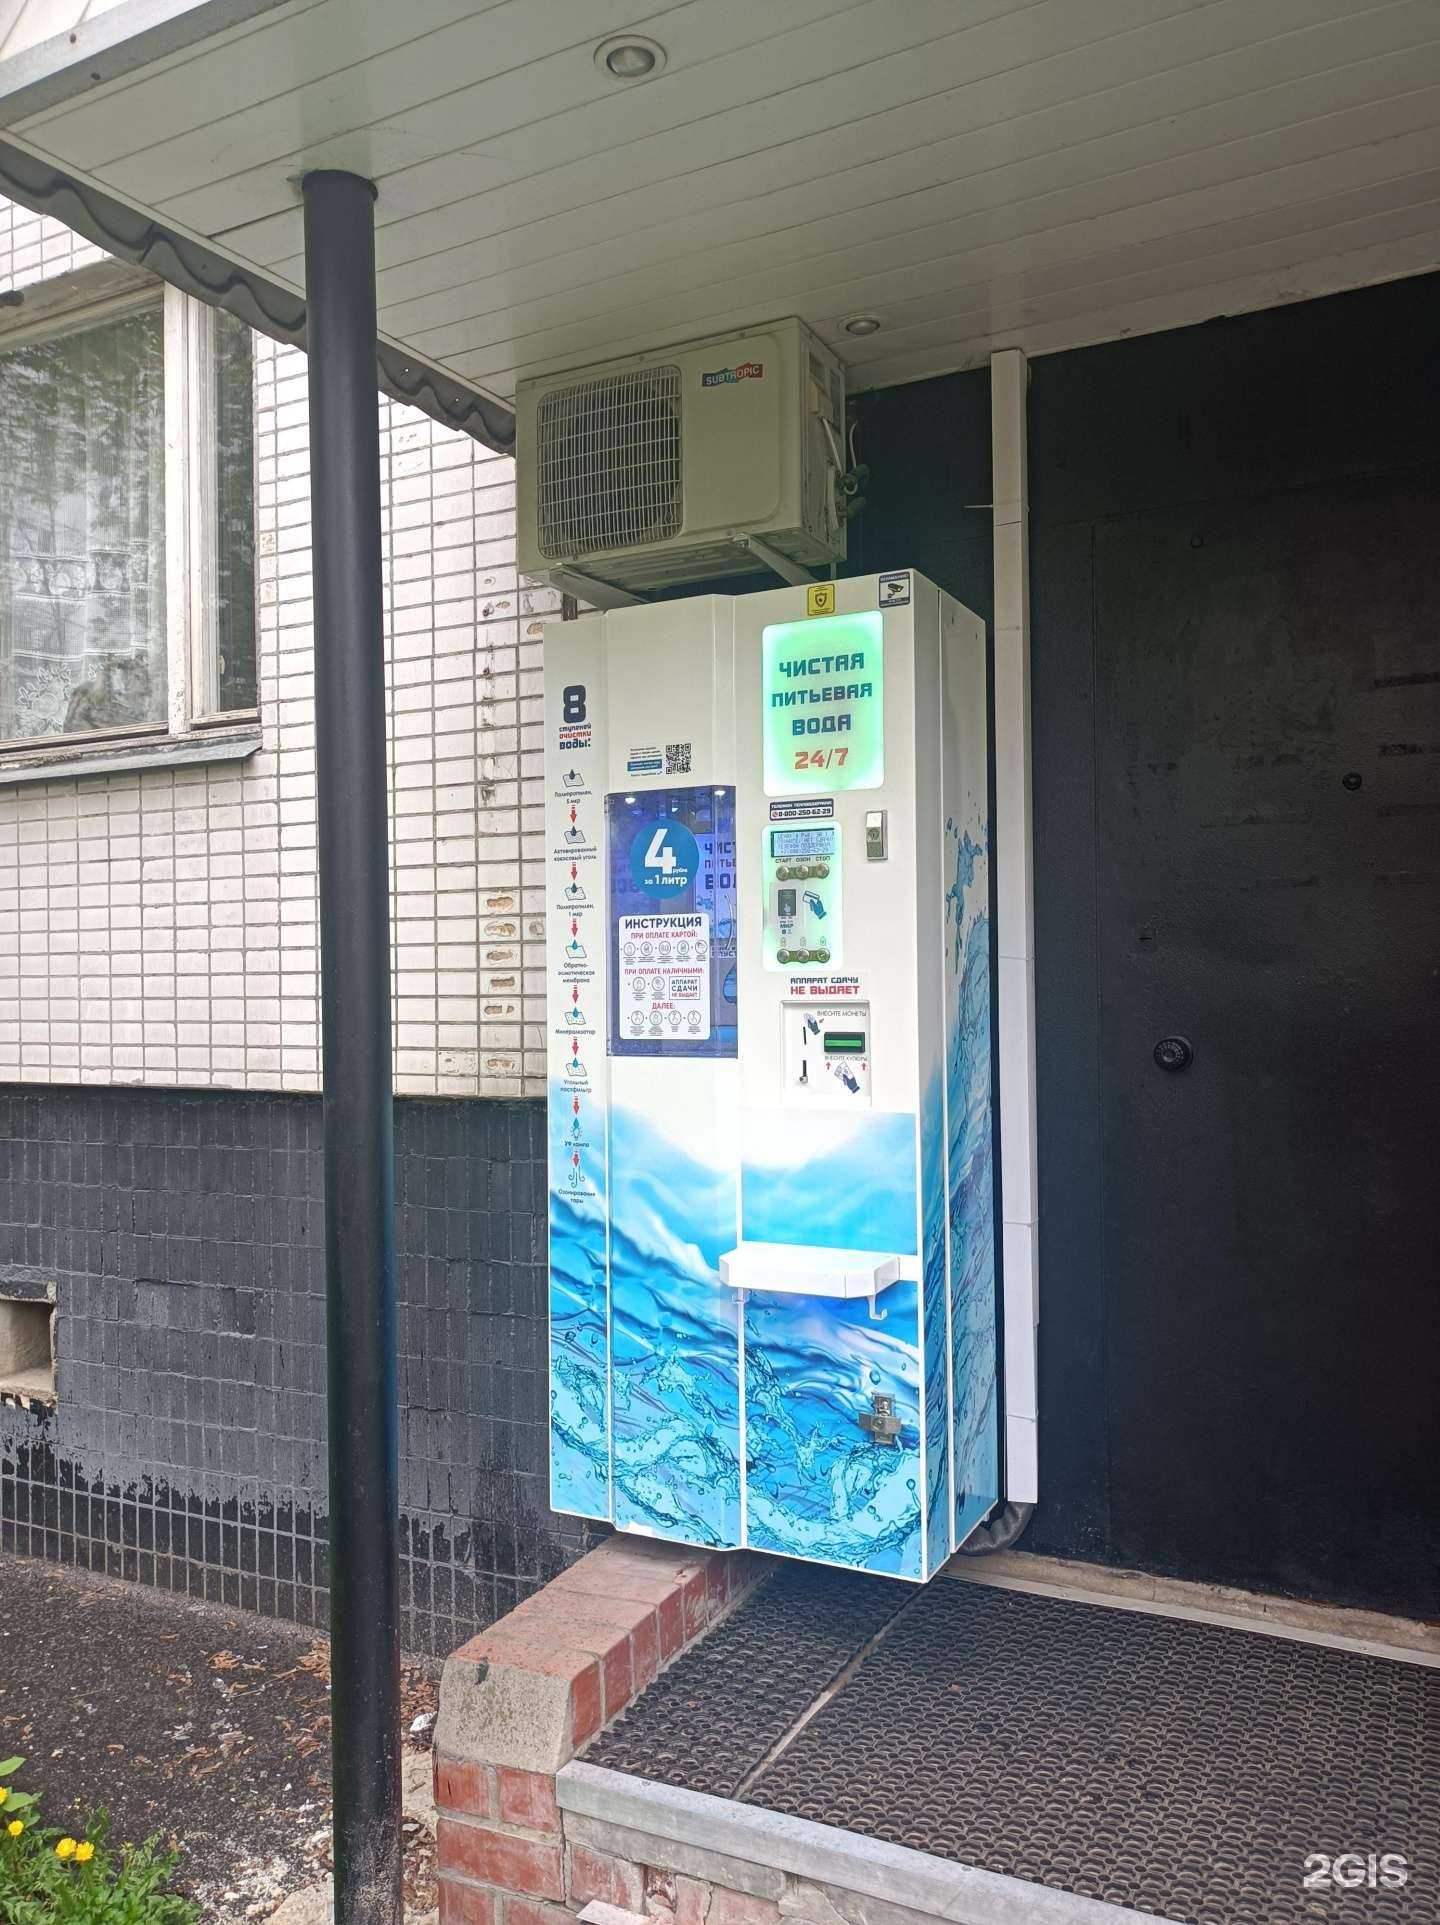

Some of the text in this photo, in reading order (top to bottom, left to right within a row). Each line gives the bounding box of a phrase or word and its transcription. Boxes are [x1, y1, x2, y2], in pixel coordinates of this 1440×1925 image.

[703, 364, 761, 386] SUBTROPIC
[779, 652, 865, 678] ЧИСТАЯ
[563, 685, 587, 723] 8
[772, 683, 873, 707] ПИТЬЕВАЯ
[559, 731, 592, 739] очистки
[792, 714, 852, 736] ВОДА
[559, 738, 591, 750] воды:
[794, 748, 849, 770] 24/7
[645, 828, 677, 875] 4
[654, 874, 660, 885] 1
[661, 876, 688, 887] литр
[624, 917, 702, 929] ИНСТРУКЦИЯ
[645, 931, 669, 939] ОПЛАТЕ
[790, 985, 860, 995] НЕ ВЫДАЕТ
